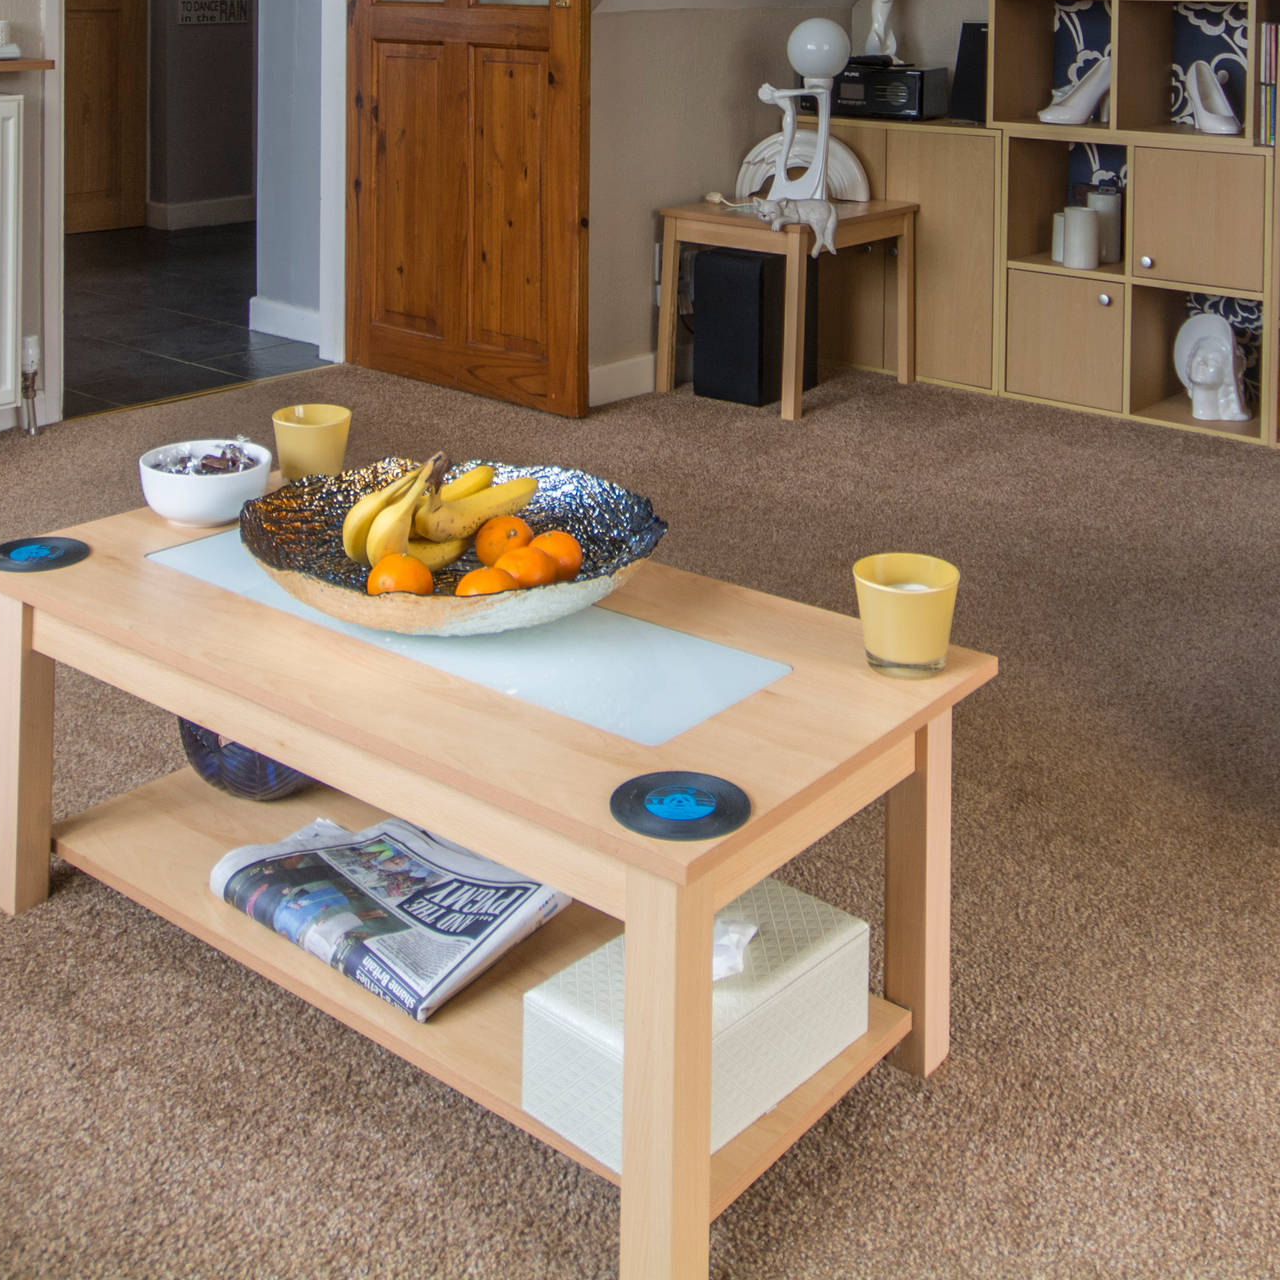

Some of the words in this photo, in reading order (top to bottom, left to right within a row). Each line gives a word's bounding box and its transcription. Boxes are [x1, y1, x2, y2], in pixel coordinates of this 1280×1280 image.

[403, 898, 449, 925] THE
[423, 880, 526, 916] PYGMY
[362, 955, 391, 987] Britain
[388, 978, 417, 1010] shame
